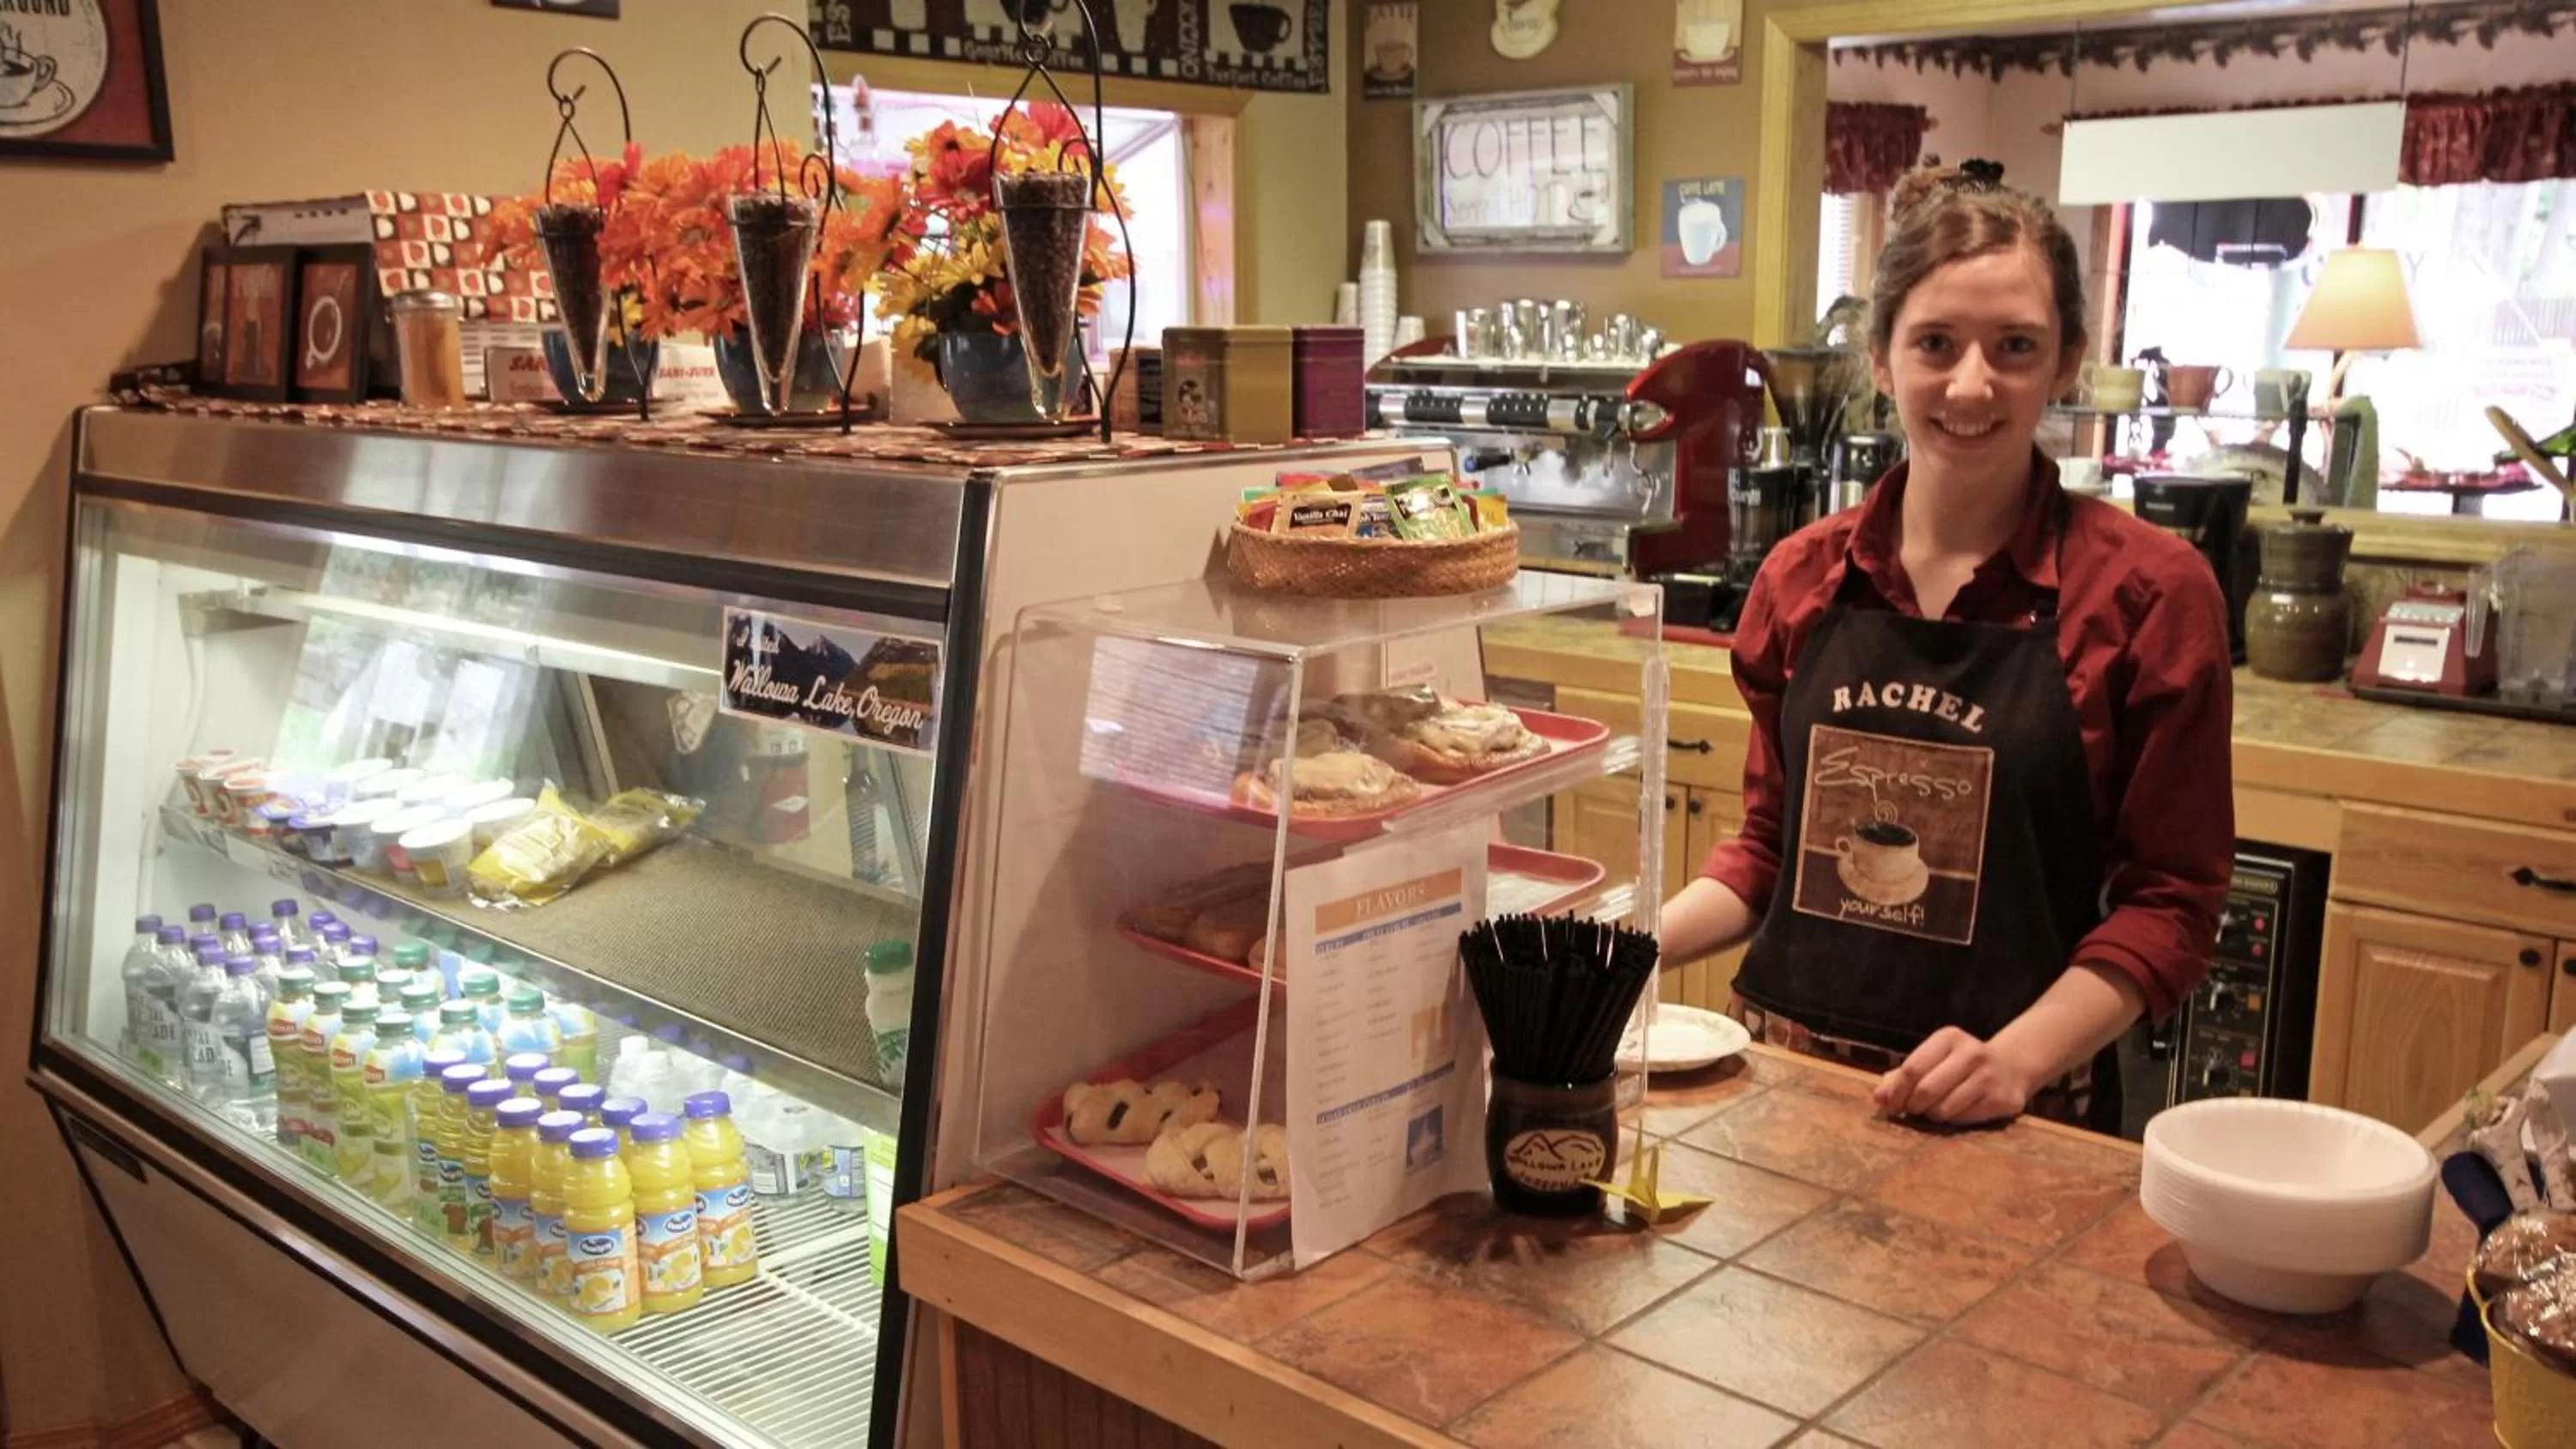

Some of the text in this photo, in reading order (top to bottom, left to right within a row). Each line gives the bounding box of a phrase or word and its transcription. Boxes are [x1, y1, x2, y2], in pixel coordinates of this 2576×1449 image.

[1446, 115, 1609, 179] COFFEE
[1293, 504, 1349, 521] Vanilla Chai
[729, 659, 925, 734] Wallowa Lake, Oregon
[1832, 681, 1986, 733] RACHEL
[1814, 745, 1972, 800] Espresso
[1356, 882, 1430, 919] FLAVORS
[1840, 899, 1925, 928] yourself!
